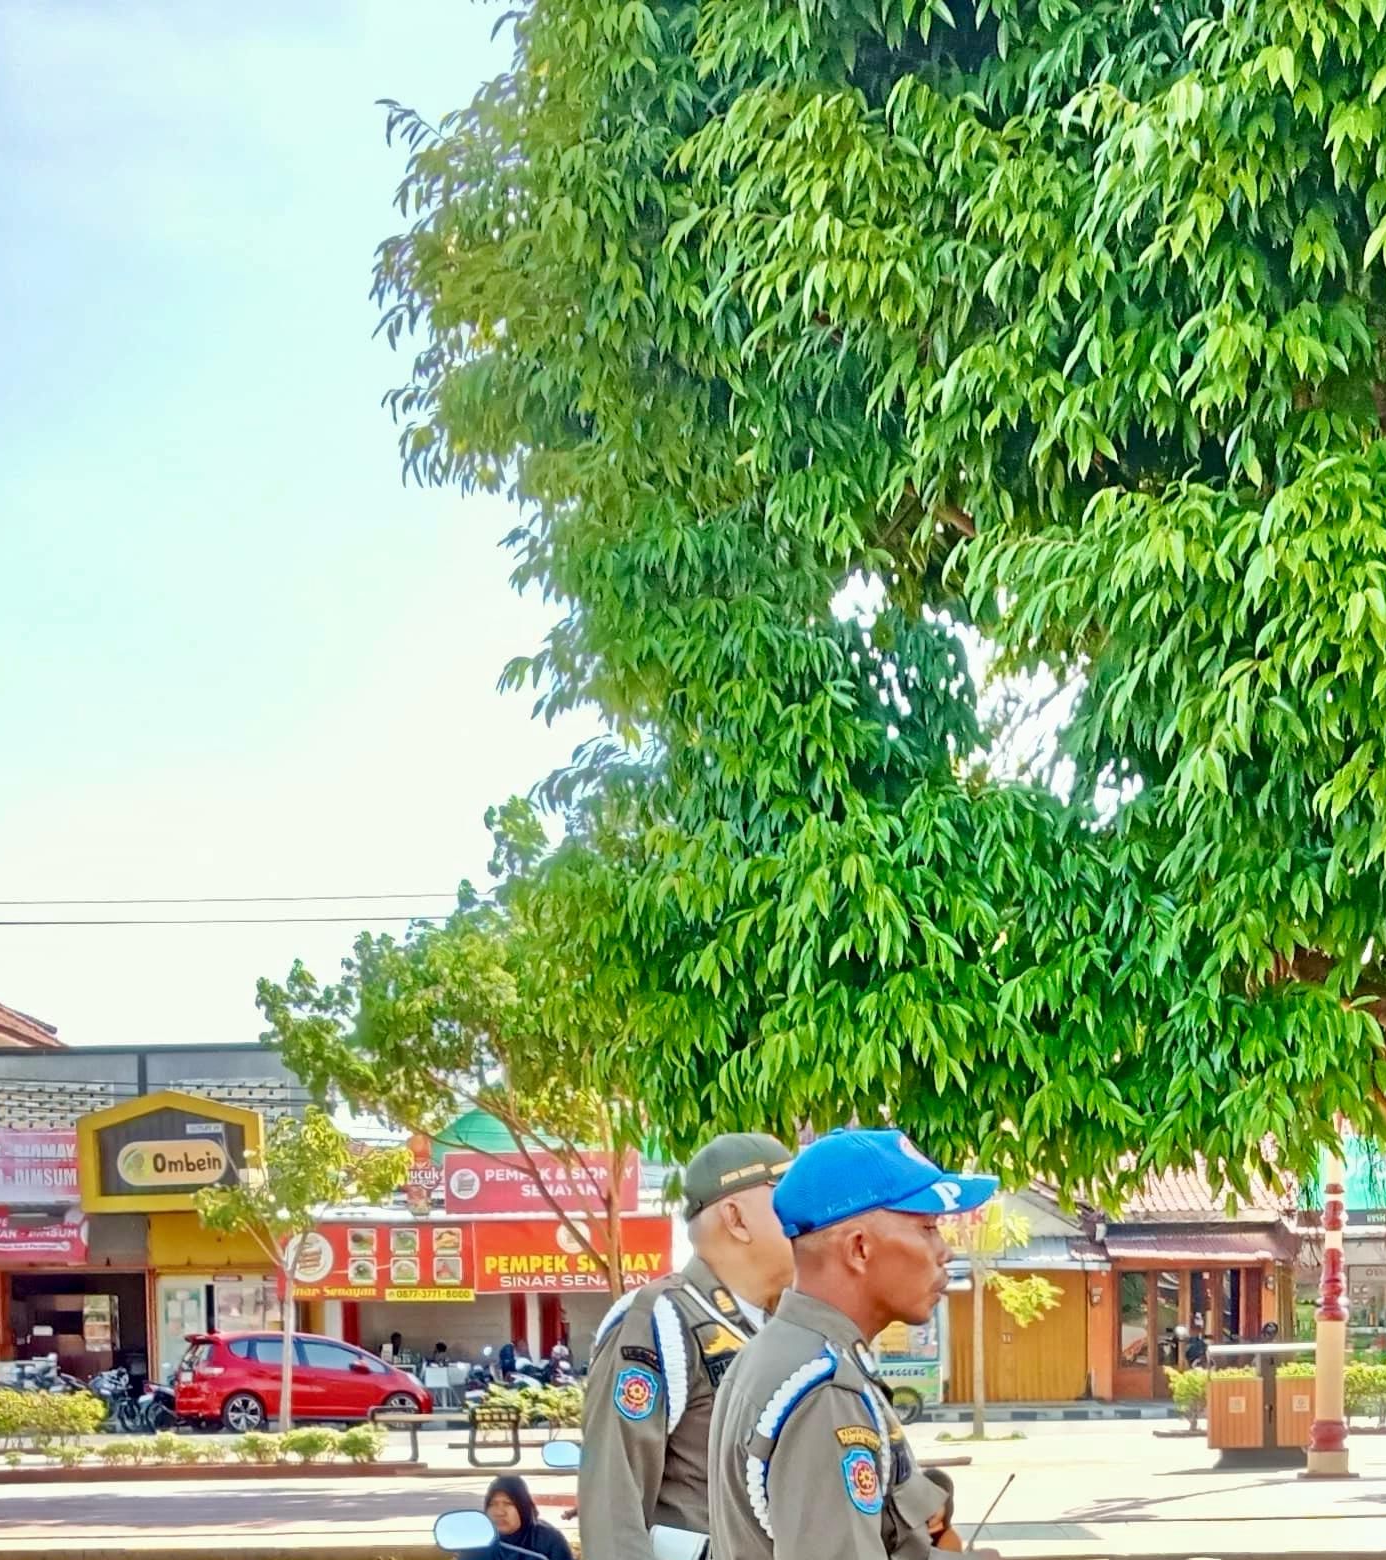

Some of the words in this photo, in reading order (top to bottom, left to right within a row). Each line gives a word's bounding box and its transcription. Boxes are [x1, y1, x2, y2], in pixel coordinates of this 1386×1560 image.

[153, 1152, 222, 1173] Ombein
[484, 1254, 569, 1274] PEMPEK
[500, 1275, 557, 1288] SINAR
[561, 1273, 650, 1286] SENAN
